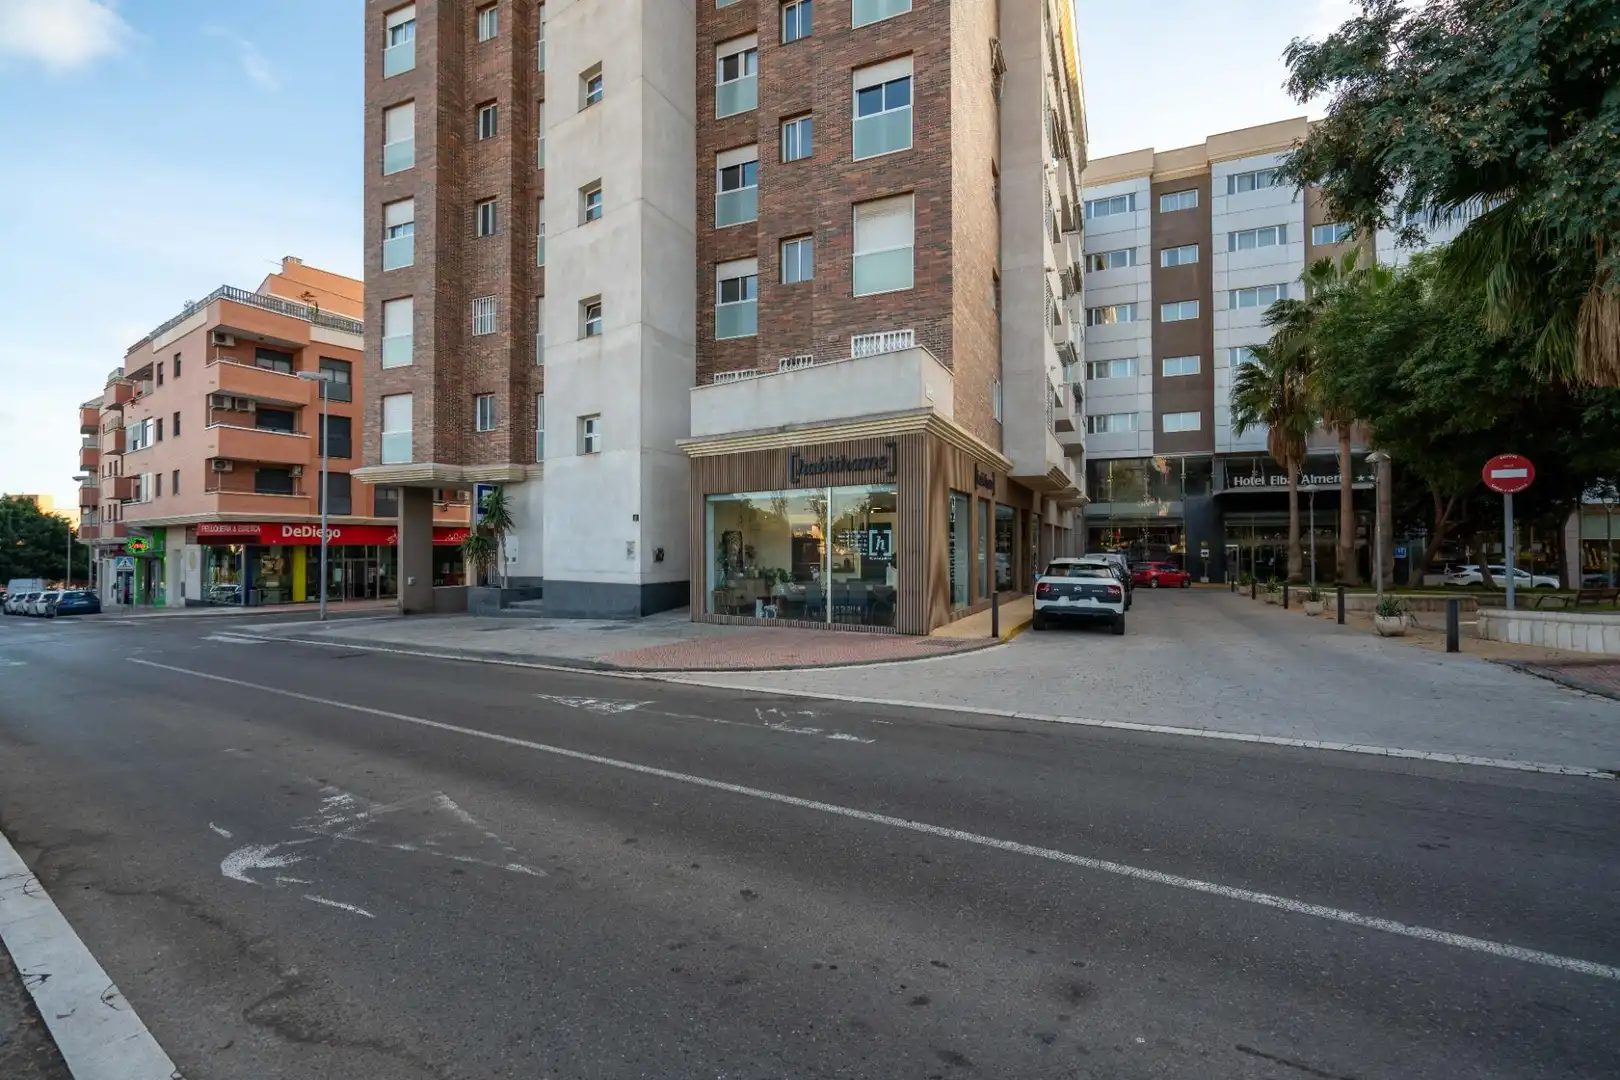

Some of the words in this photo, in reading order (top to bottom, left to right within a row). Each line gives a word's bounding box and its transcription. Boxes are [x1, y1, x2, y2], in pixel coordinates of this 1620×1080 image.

[1233, 475, 1265, 486] Hotel
[1301, 473, 1342, 484] Almer
[282, 525, 341, 543] DeDiego
